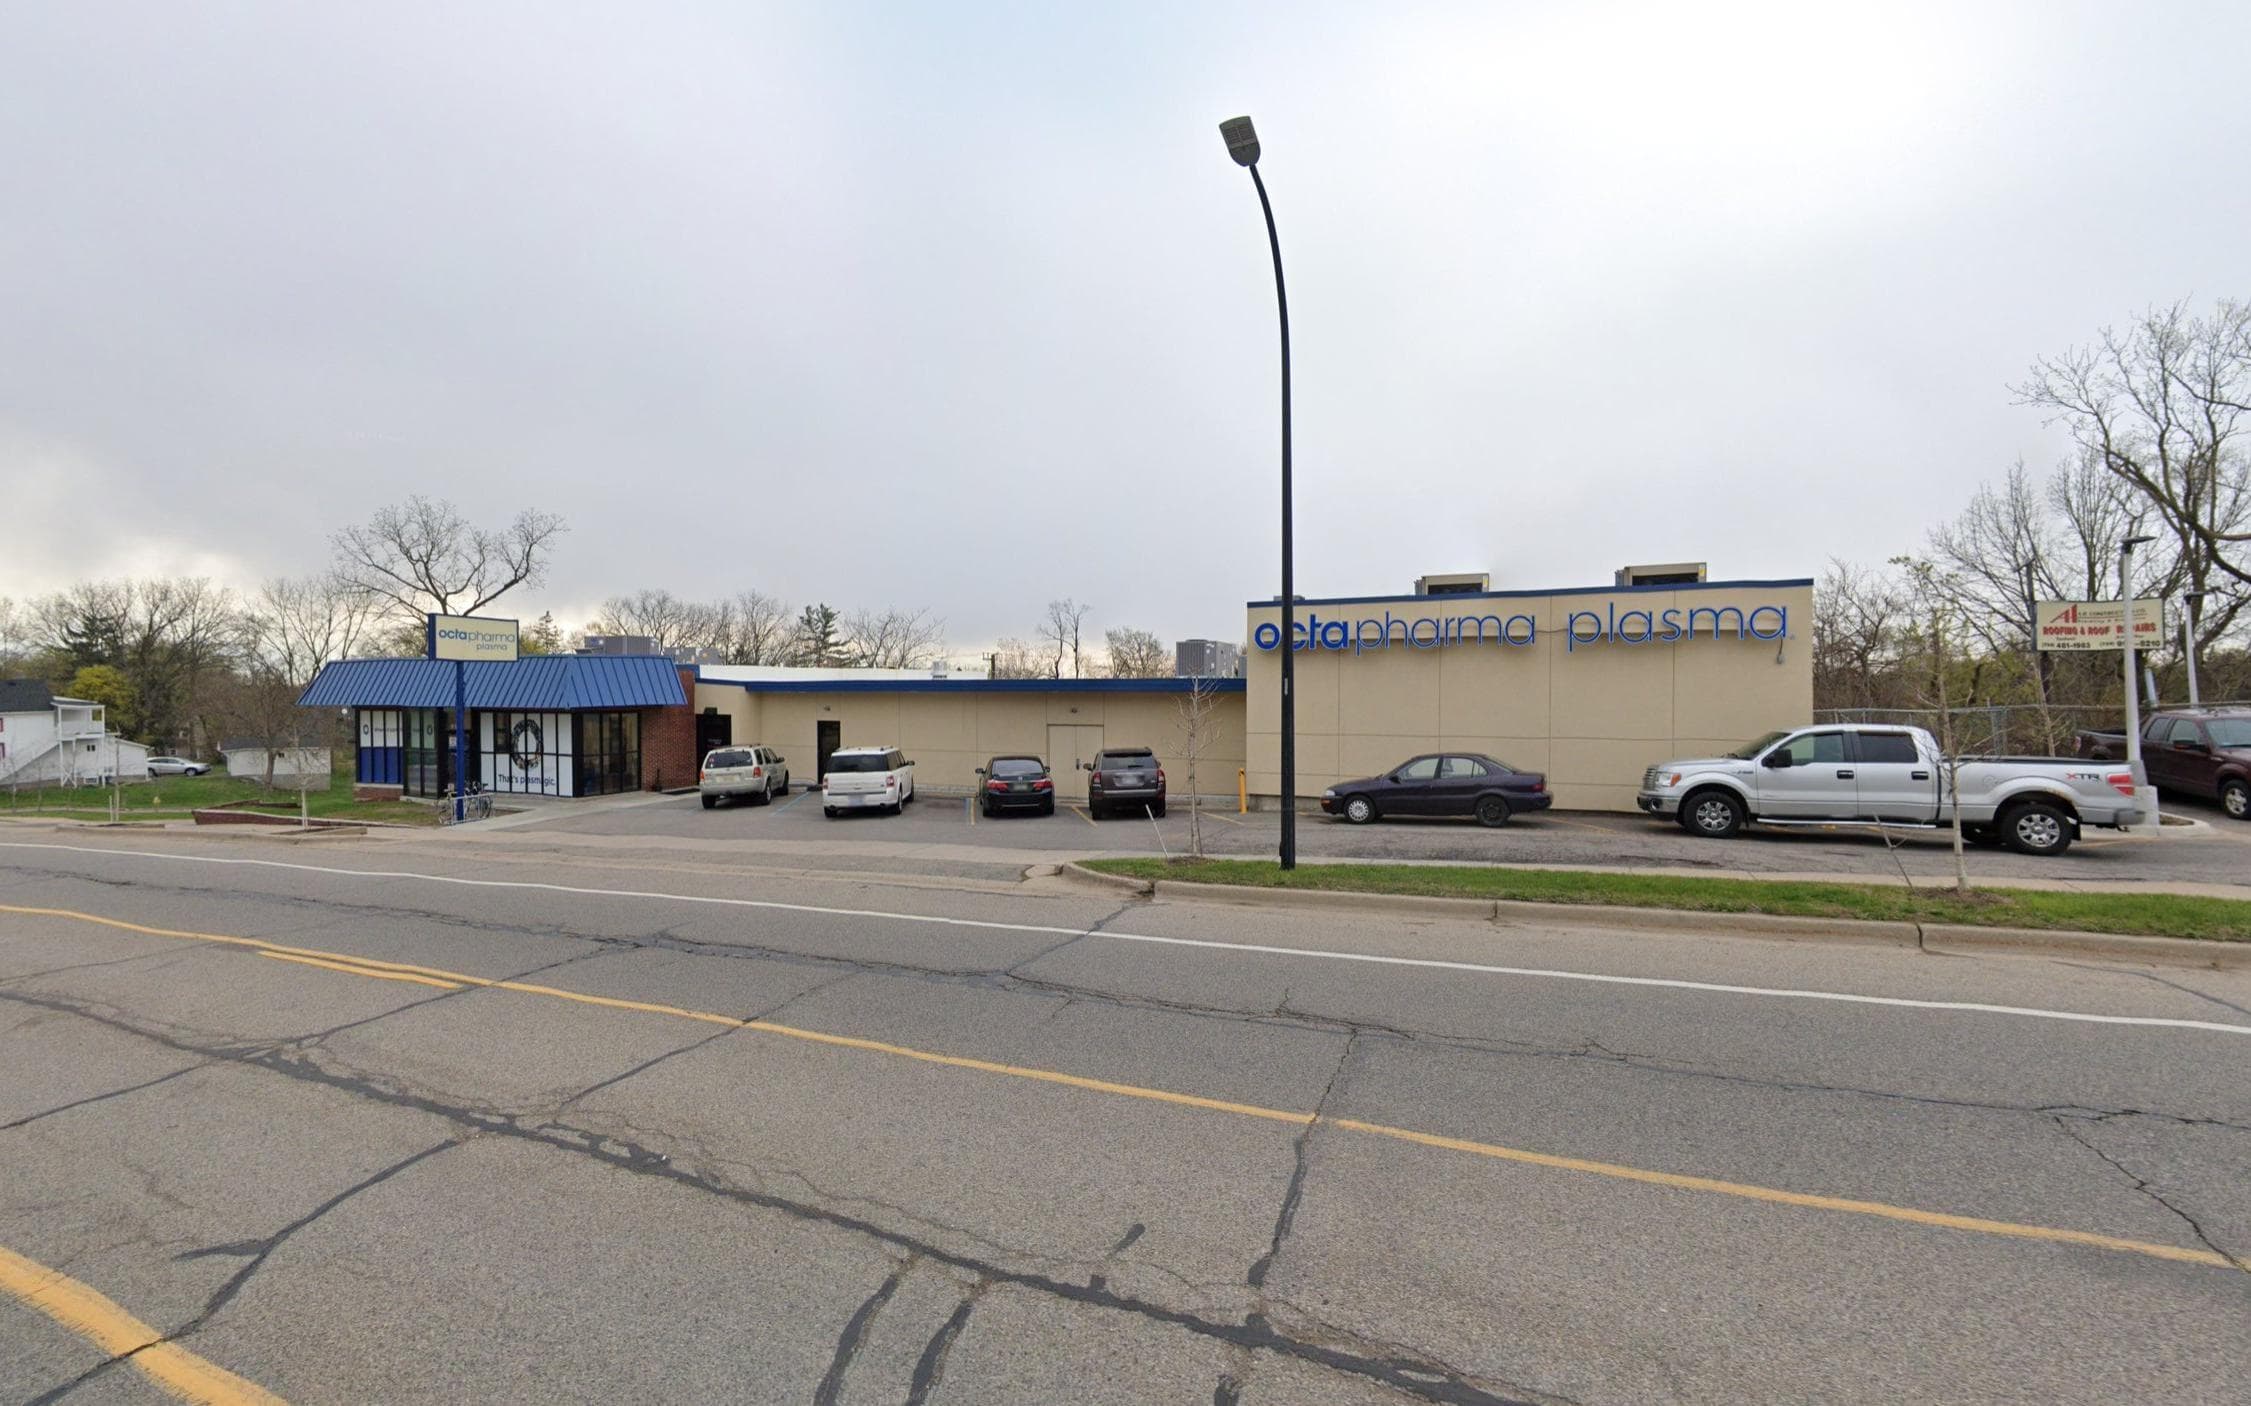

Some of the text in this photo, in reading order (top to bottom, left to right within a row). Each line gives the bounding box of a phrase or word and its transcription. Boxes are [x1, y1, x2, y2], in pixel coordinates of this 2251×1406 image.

[1568, 602, 1787, 653] plasma
[2043, 626, 2078, 635] ROOFING
[2088, 625, 2110, 635] ROOF
[2116, 623, 2156, 634] RAIRS
[438, 628, 515, 643] octapharma
[476, 642, 508, 651] plasma
